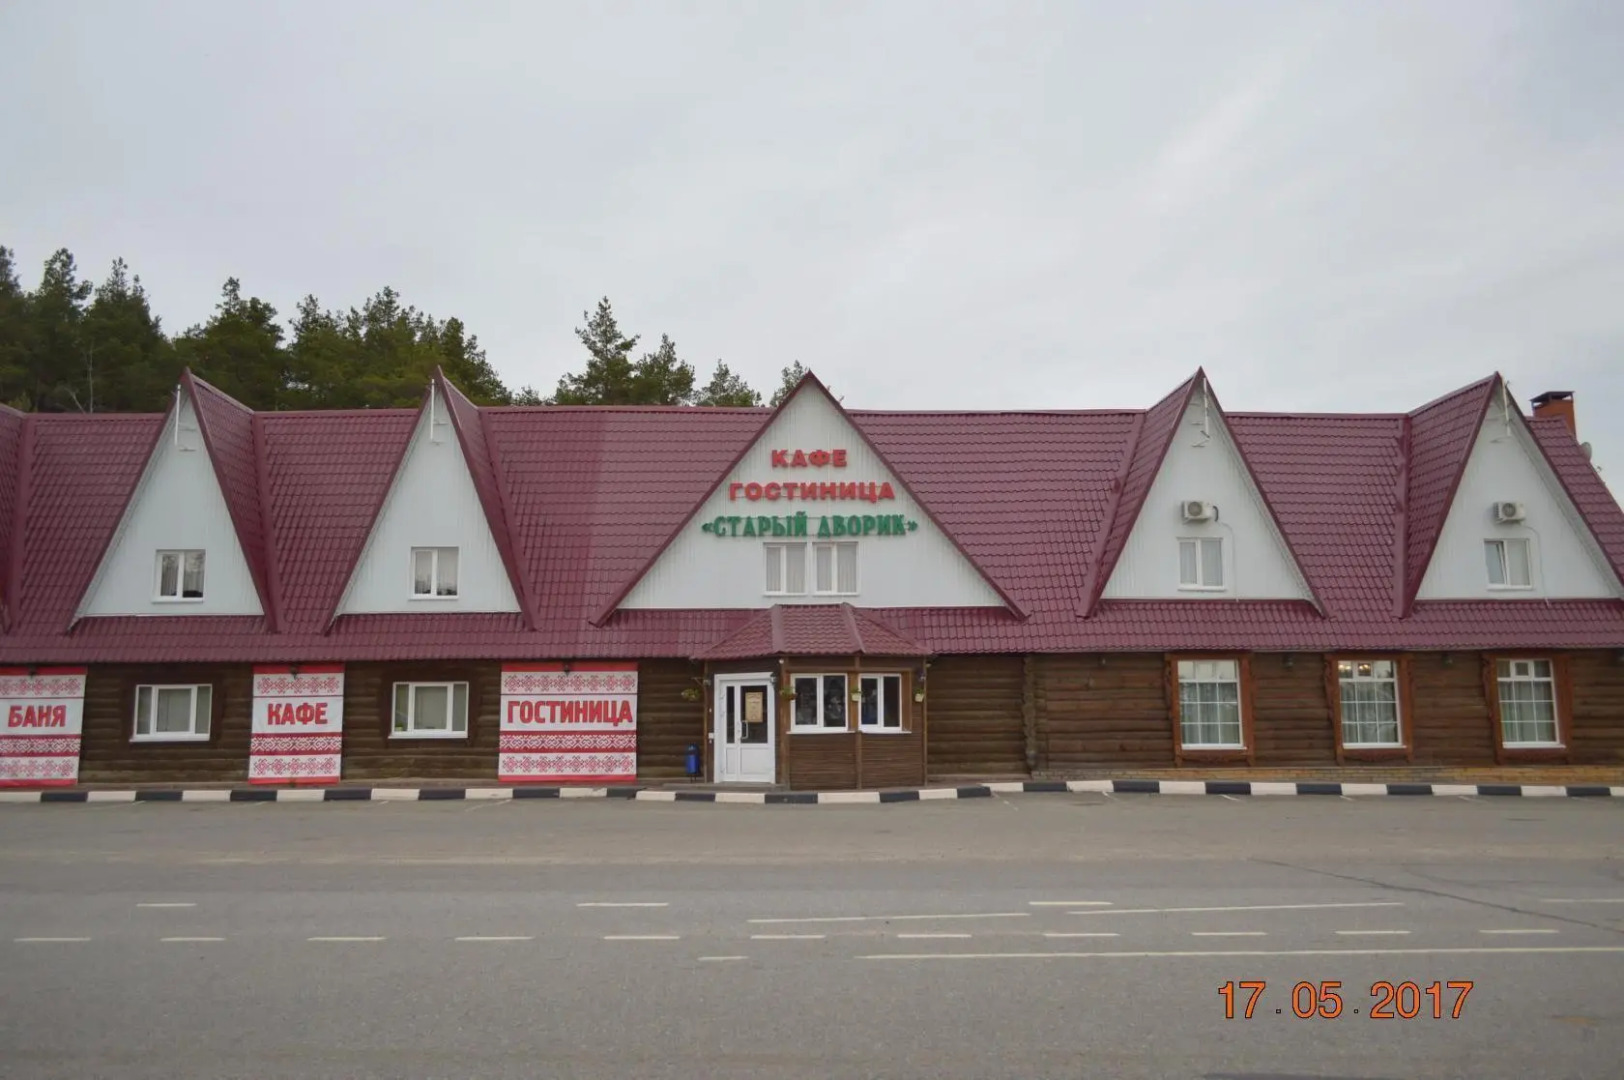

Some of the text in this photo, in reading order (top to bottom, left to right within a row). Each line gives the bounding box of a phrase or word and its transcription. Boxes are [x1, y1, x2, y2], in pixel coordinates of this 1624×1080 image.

[771, 449, 847, 468] КАФЕ
[729, 482, 895, 503] ГОСТИНИЦА
[702, 511, 918, 537] «СТАРЫЙ ДВОРИК»
[8, 705, 66, 727] БАНЯ
[267, 703, 327, 725] КАФЕ
[507, 700, 633, 727] ГОСТИНИЦА
